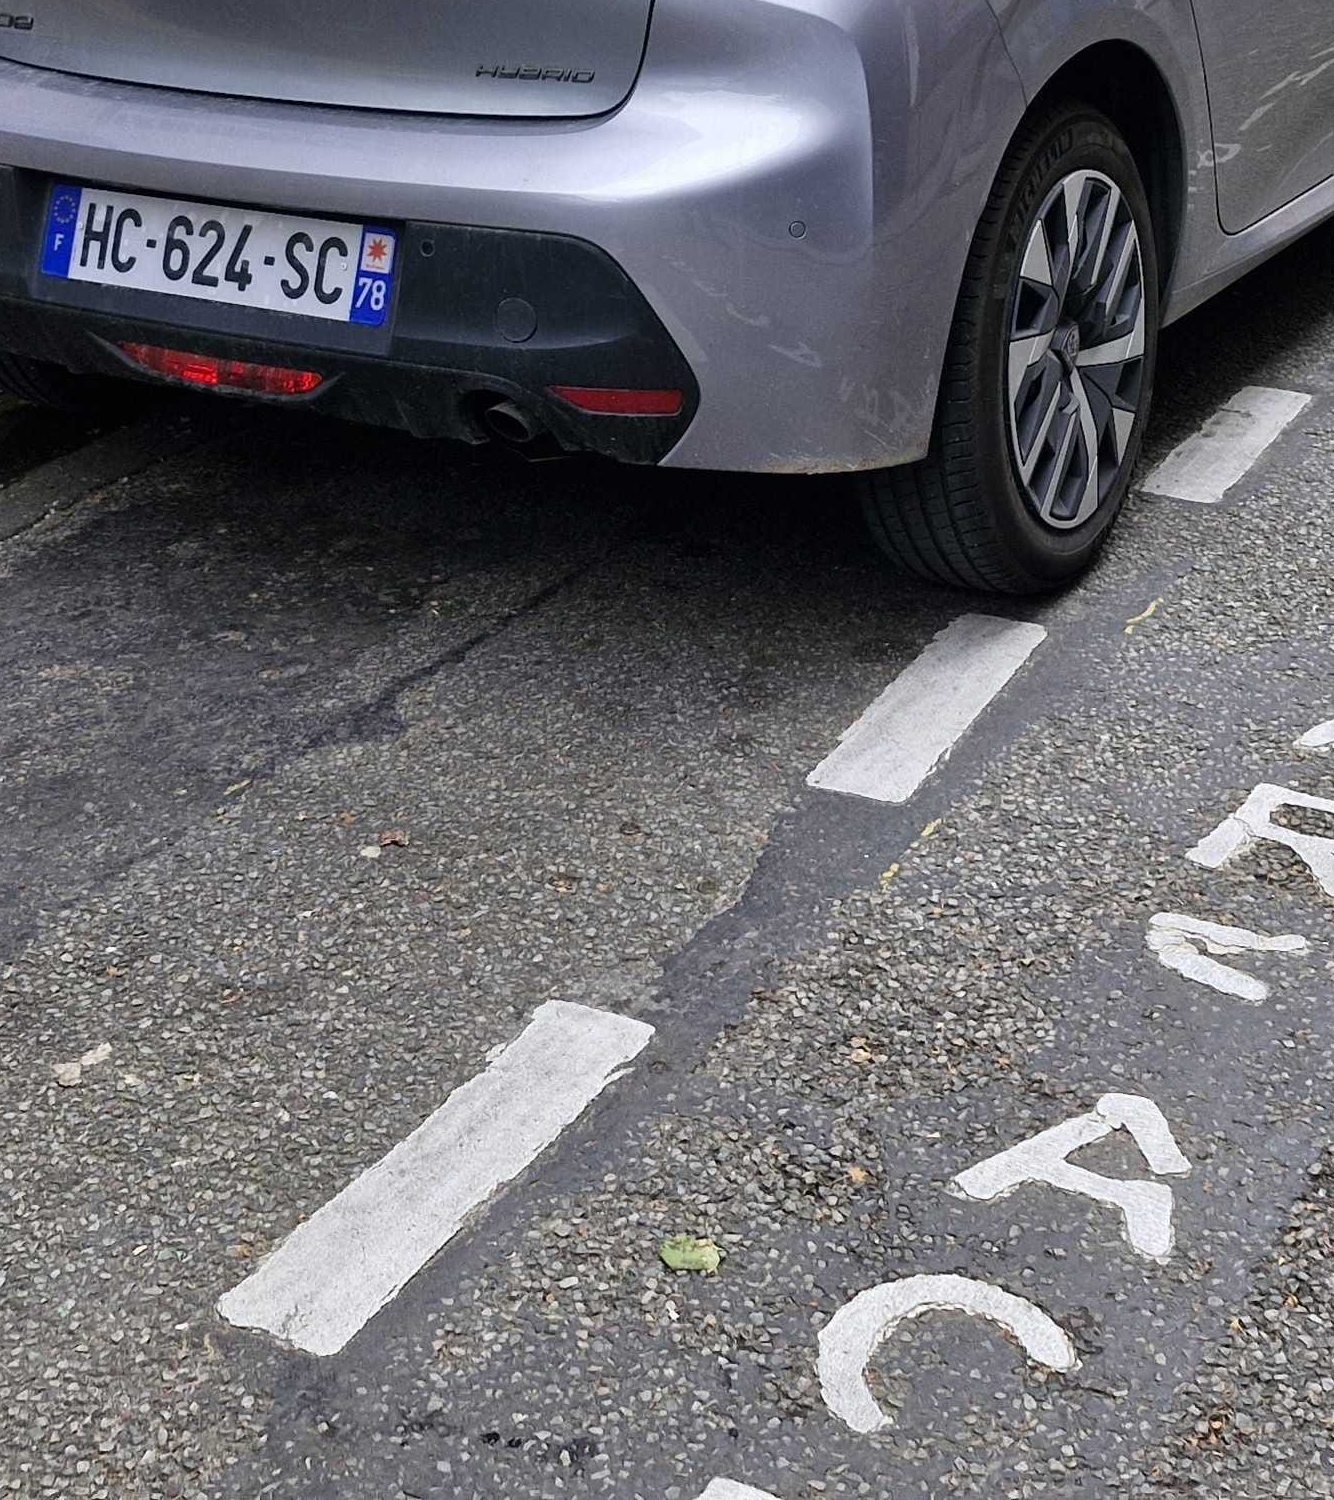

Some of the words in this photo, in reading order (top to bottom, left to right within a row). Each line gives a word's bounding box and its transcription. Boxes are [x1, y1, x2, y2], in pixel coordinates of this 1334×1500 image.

[475, 64, 595, 84] HYBRID
[53, 233, 65, 252] F
[79, 202, 349, 305] HC-624-SC
[355, 276, 387, 311] 78
